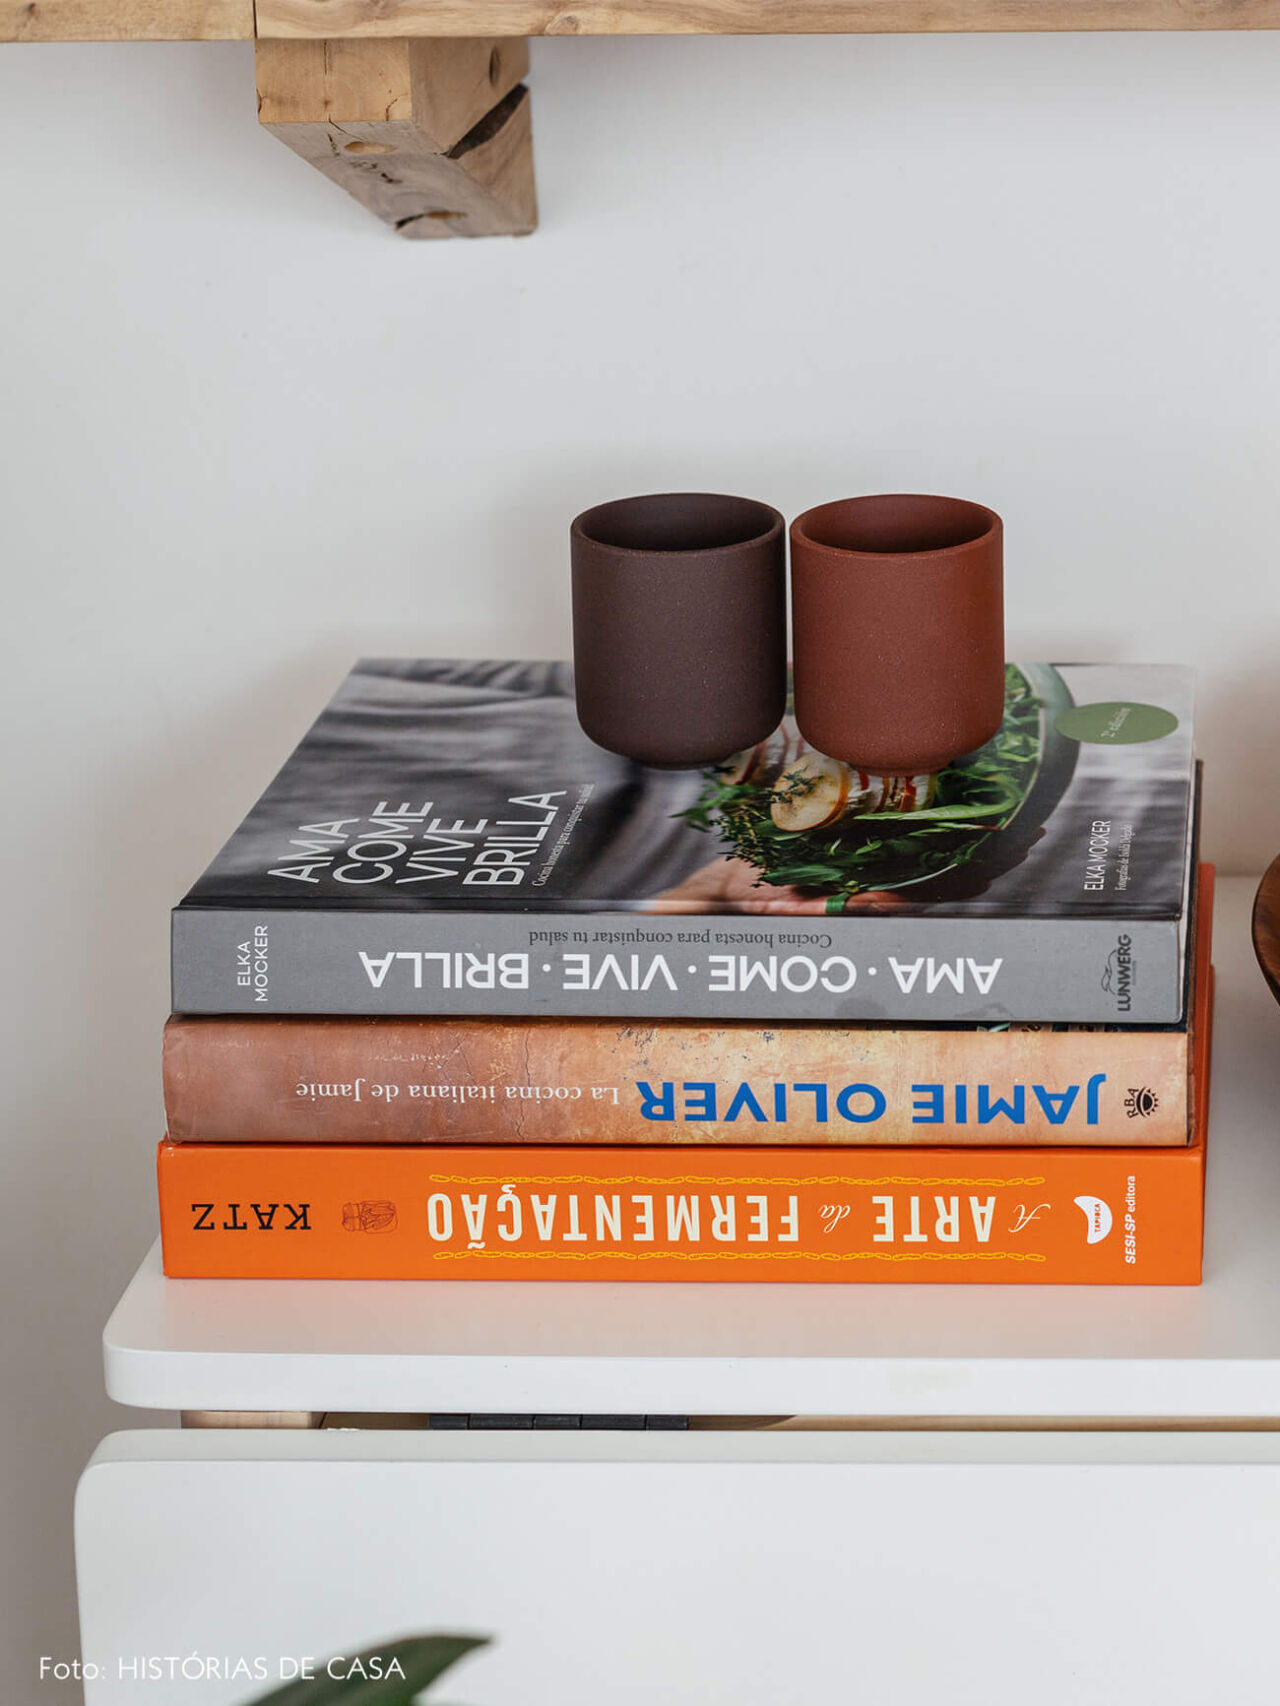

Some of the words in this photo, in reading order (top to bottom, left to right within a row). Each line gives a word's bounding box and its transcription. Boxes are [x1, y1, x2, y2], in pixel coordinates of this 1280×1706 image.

[267, 818, 360, 883] AMA
[332, 801, 434, 884] COME
[395, 818, 488, 884] VIVE
[462, 790, 567, 885] BRILLA
[556, 832, 571, 845] para
[1088, 820, 1111, 862] MOCKER
[541, 845, 564, 866] honesta
[531, 867, 553, 886] Cocina
[1084, 864, 1106, 890] ELKA
[529, 931, 569, 945] salud
[573, 931, 588, 944] tu
[593, 928, 673, 944] conquistar
[677, 929, 711, 944] para
[715, 933, 774, 948] honesta
[778, 934, 833, 949] Cocina
[237, 940, 251, 987] ELKA
[254, 925, 269, 1002] MOCKER
[358, 951, 530, 989] BRILLA
[562, 953, 678, 992] VIVE
[708, 955, 857, 994] COME
[888, 956, 1003, 995] AMA
[1117, 933, 1132, 1012] LUNWERG
[295, 1078, 367, 1101] Jamie
[370, 1083, 400, 1103] de
[408, 1083, 496, 1104] italiana
[504, 1085, 582, 1105] cocina
[591, 1086, 620, 1105] La
[635, 1081, 887, 1124] OLIVER
[911, 1073, 1106, 1125] JAMIE
[1124, 1087, 1140, 1119] RBA
[1124, 1175, 1136, 1213] editora
[191, 1203, 311, 1231] KATZ
[427, 1184, 799, 1250] FERMENTAÇÃO
[818, 1204, 851, 1234] da
[872, 1196, 996, 1243] ARTE
[1124, 1213, 1136, 1265] SESI-SP
